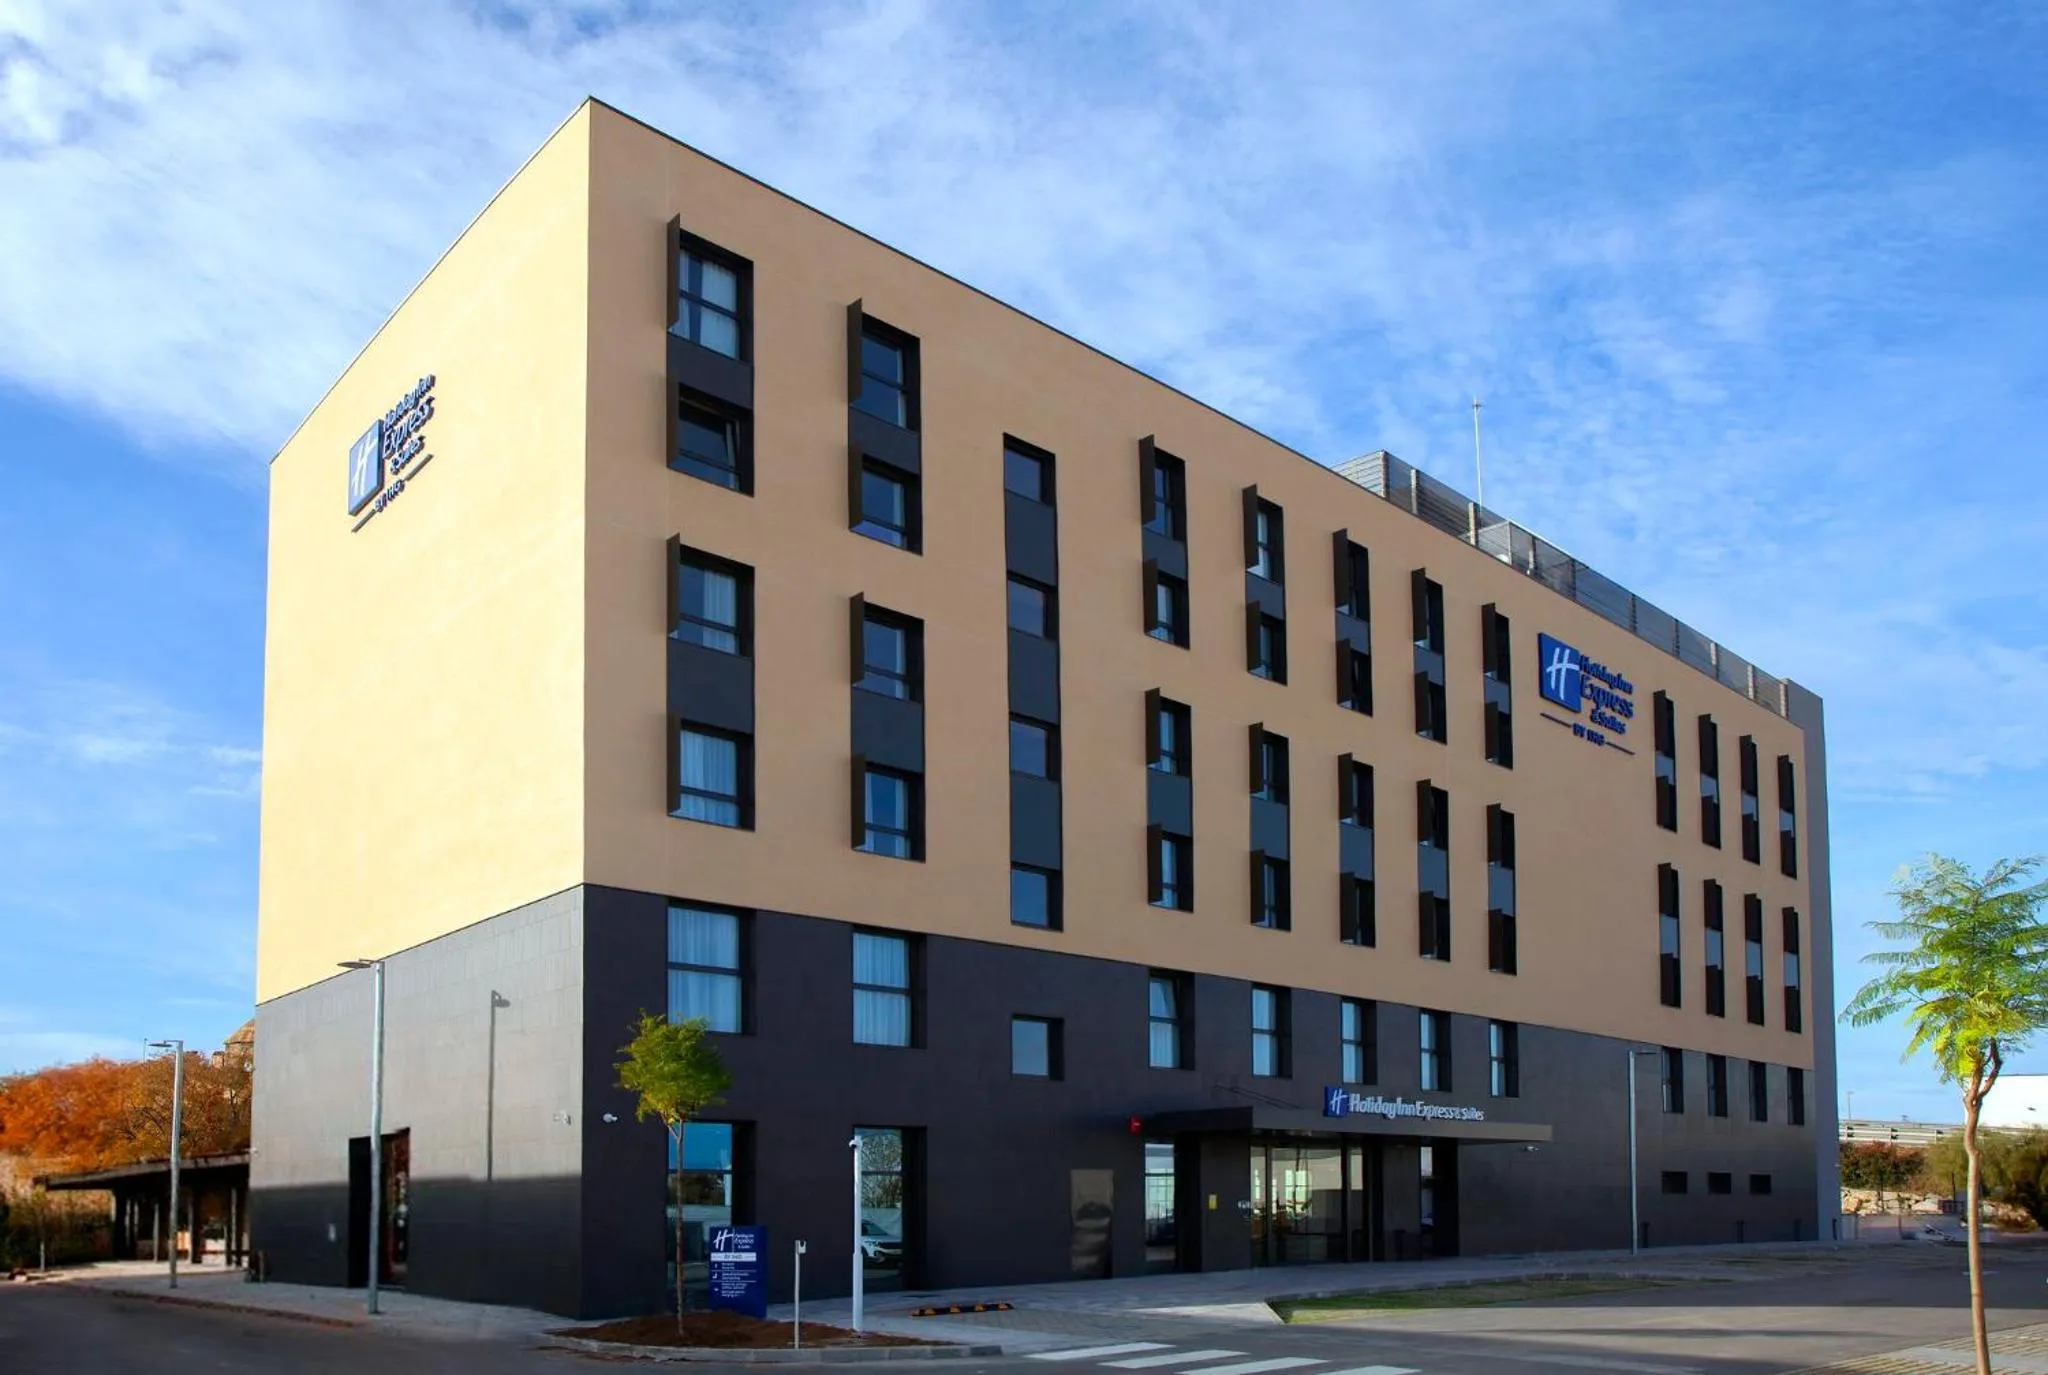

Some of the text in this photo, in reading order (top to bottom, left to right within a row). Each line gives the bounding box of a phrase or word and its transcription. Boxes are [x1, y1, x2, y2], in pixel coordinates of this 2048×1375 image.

[383, 396, 436, 459] Express
[1581, 674, 1634, 719] Express
[1572, 722, 1586, 738] BY
